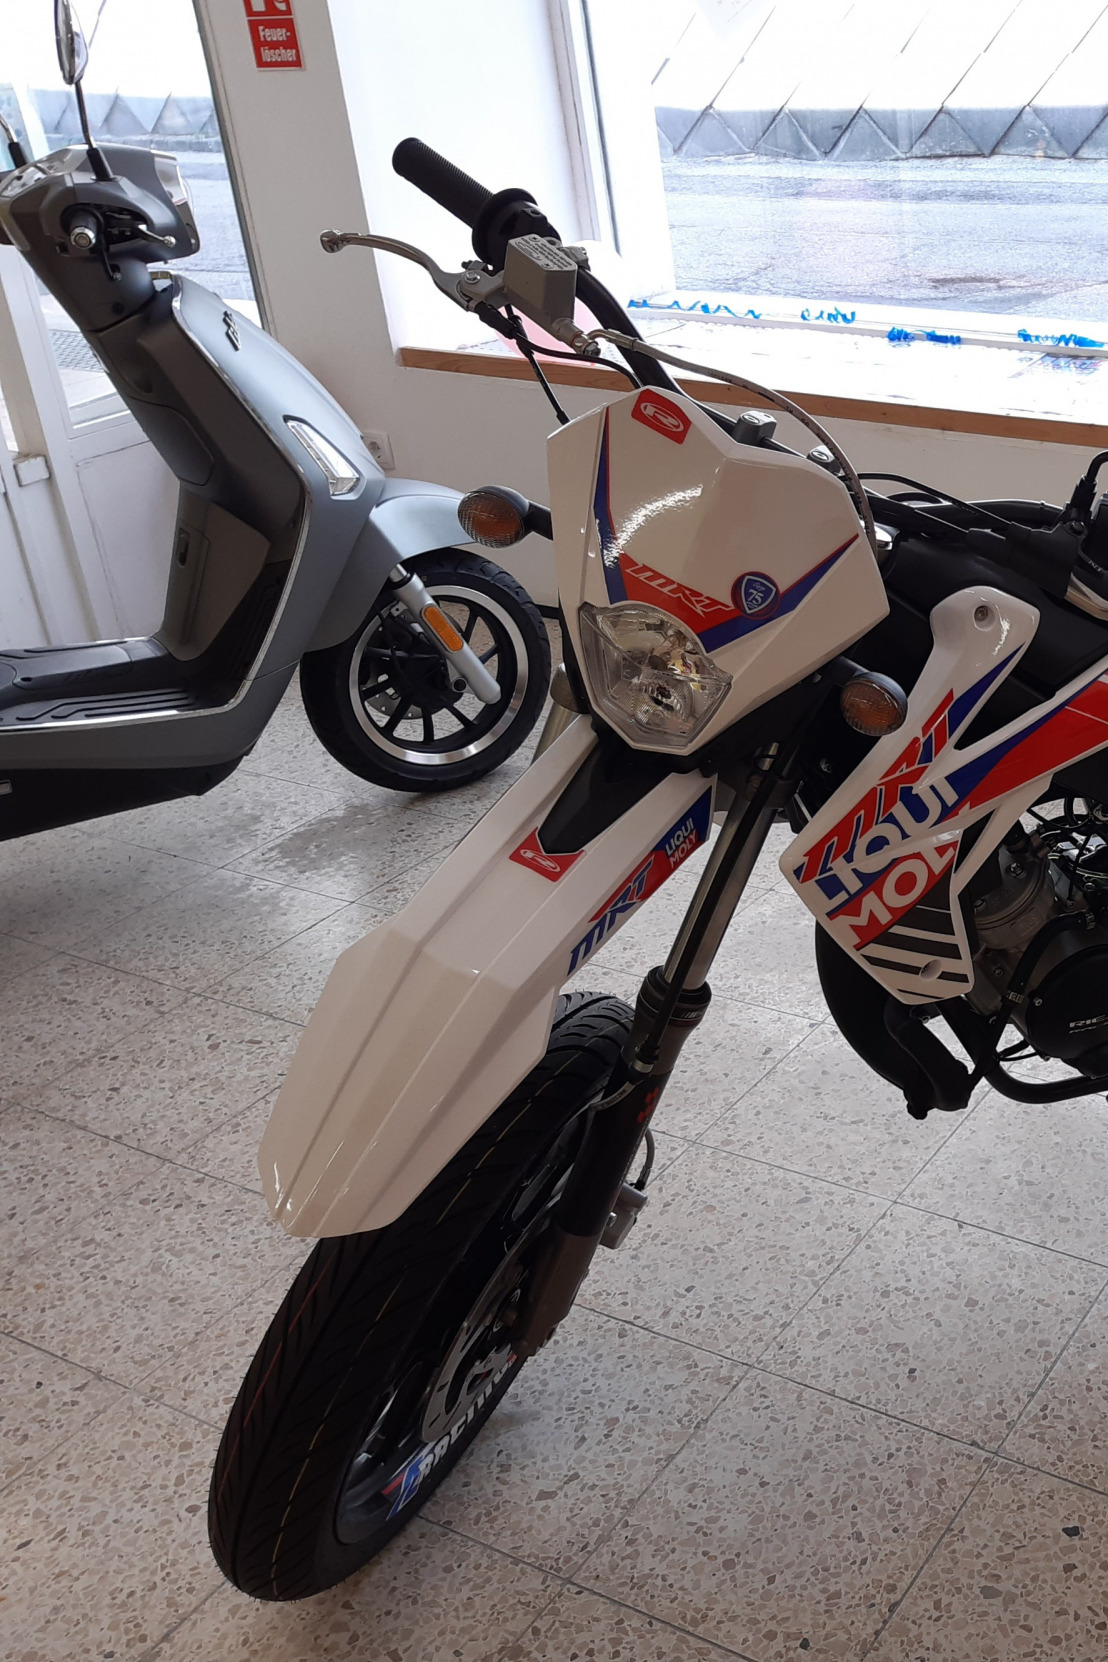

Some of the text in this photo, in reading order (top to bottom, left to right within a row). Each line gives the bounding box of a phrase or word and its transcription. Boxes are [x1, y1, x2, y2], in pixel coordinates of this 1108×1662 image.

[258, 25, 291, 42] Feuer-
[260, 46, 297, 62] löscher
[748, 589, 764, 605] 75
[665, 817, 695, 857] LIQUI
[669, 829, 697, 869] MOLY
[837, 802, 970, 949] MOL
